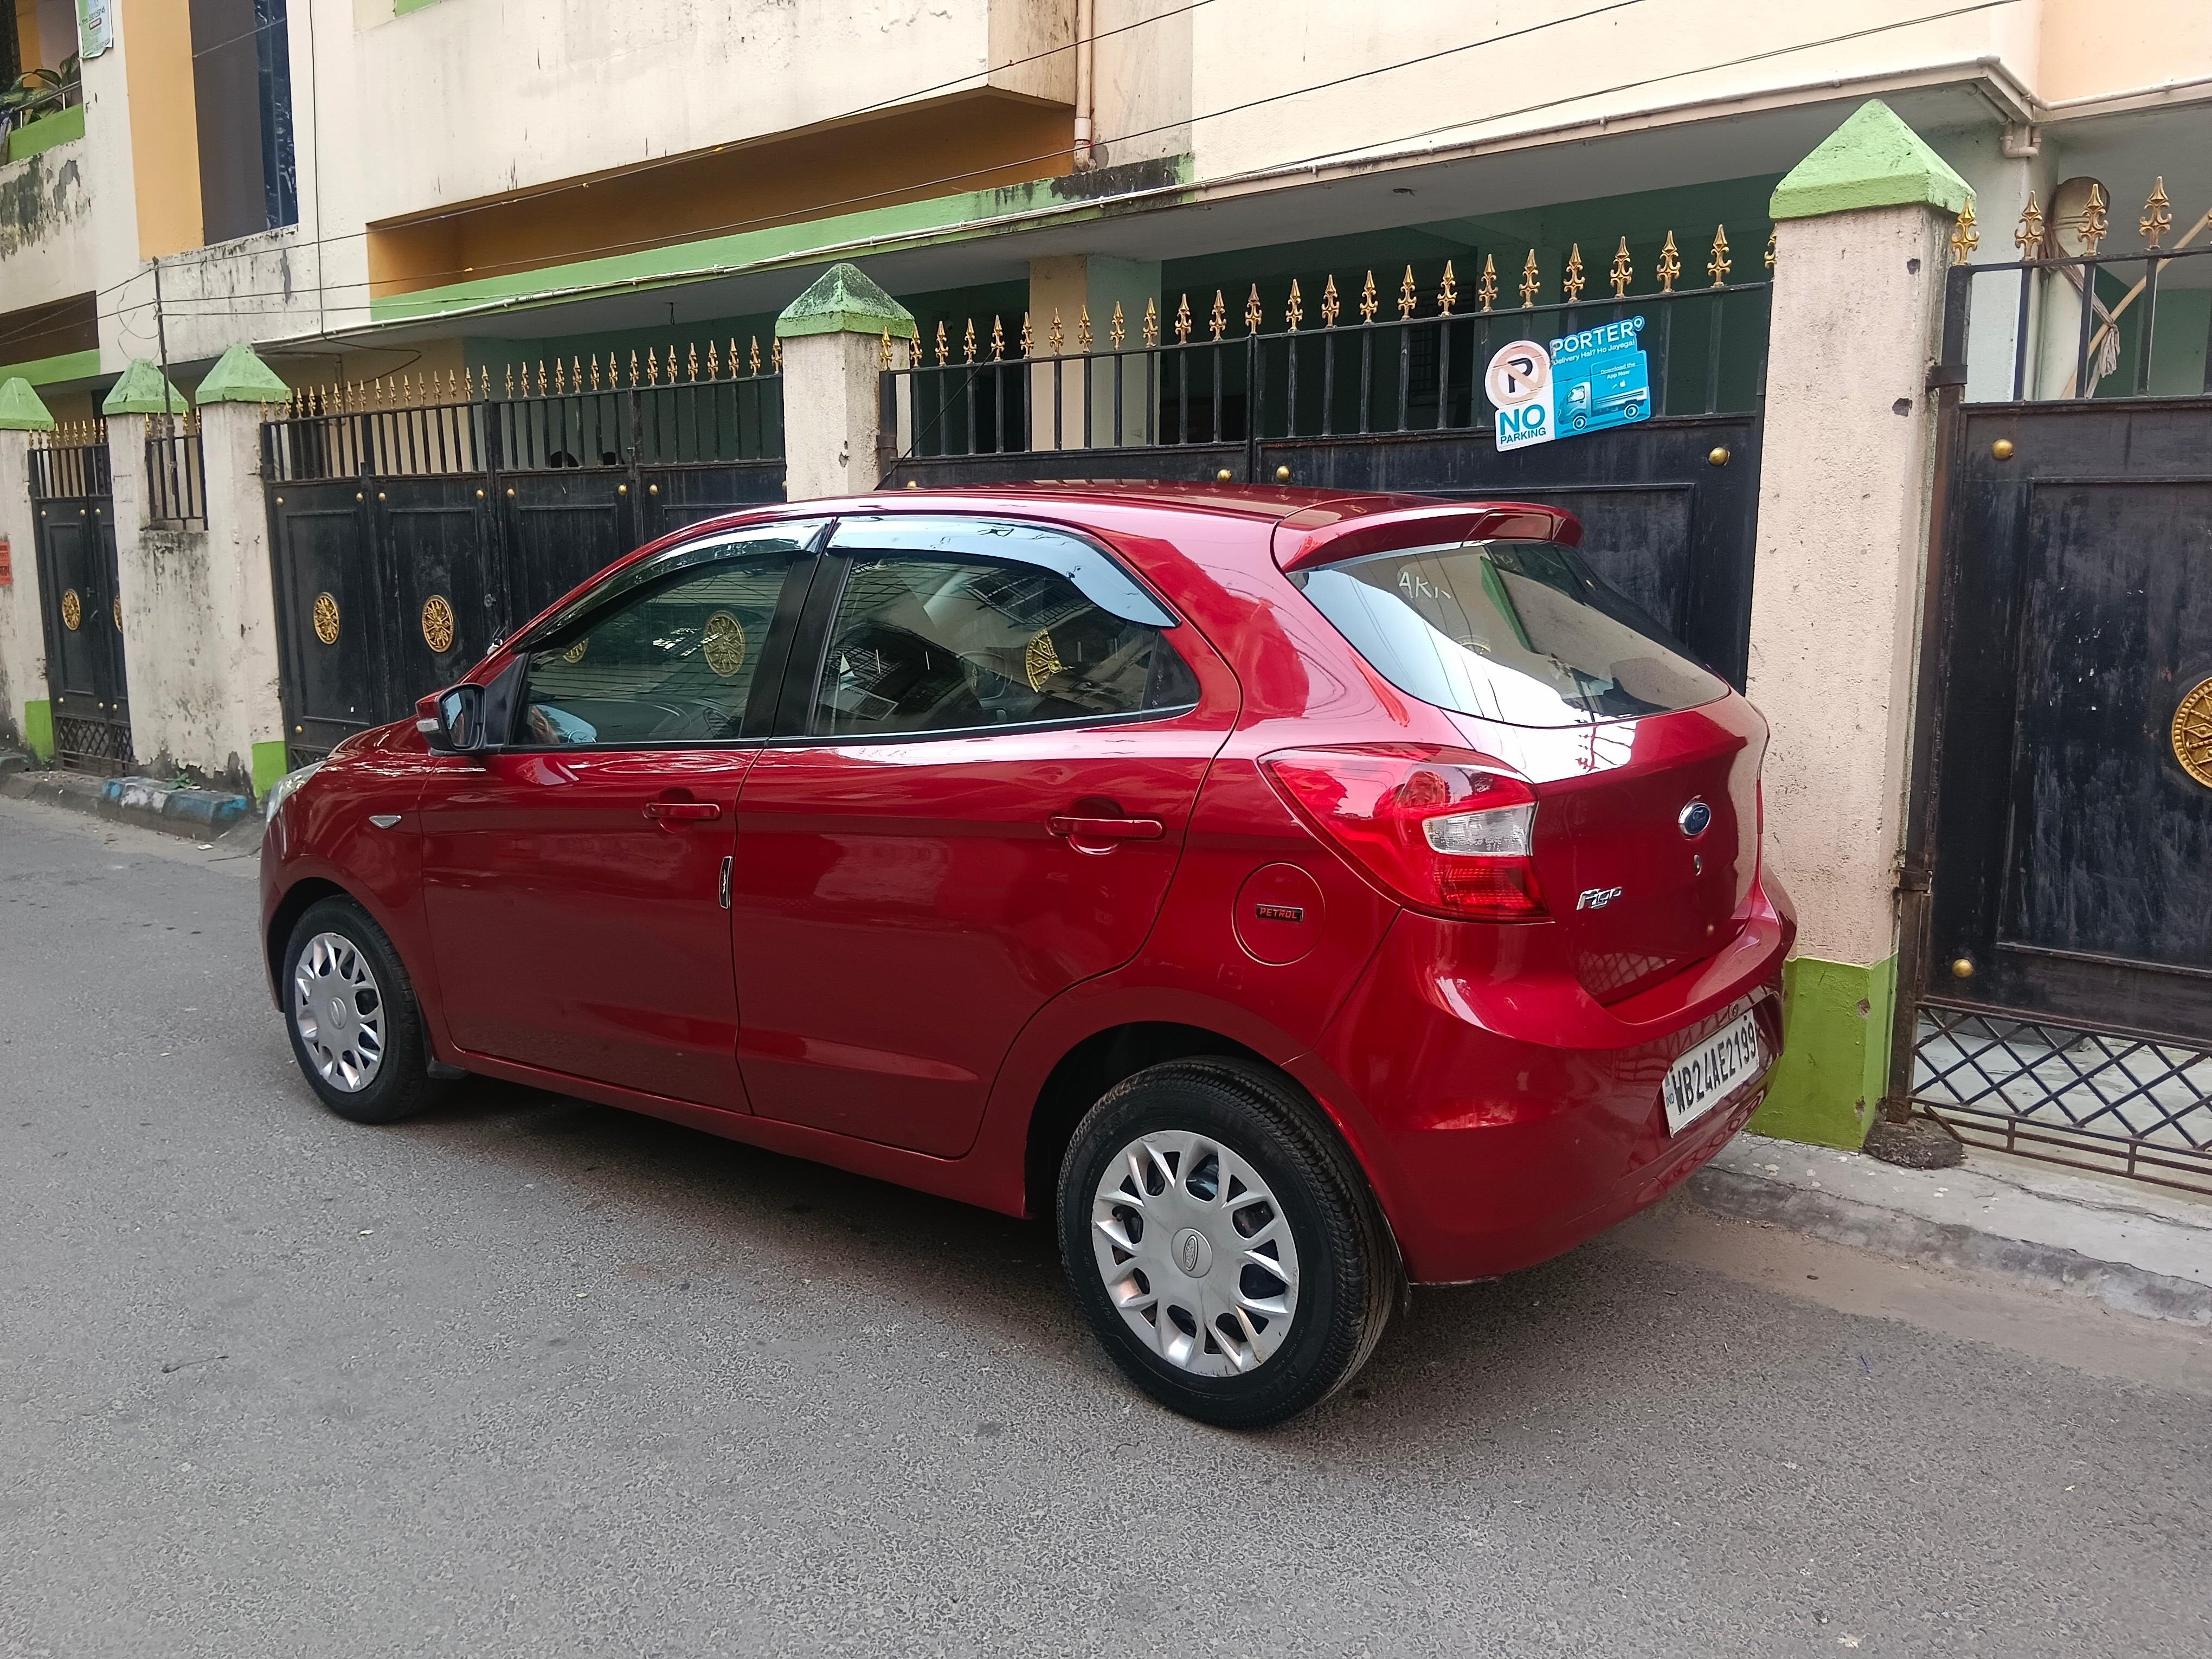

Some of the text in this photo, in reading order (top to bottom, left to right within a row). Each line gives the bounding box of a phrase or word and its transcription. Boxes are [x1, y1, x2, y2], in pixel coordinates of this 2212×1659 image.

[1553, 321, 1635, 357] PORTER
[1500, 404, 1545, 436] NO
[1500, 427, 1546, 445] PARKING
[1576, 886, 1623, 910] Figo
[1259, 906, 1297, 919] PETROL
[1671, 1021, 1757, 1115] WB24AE2199
[1666, 1092, 1675, 1108] IND
